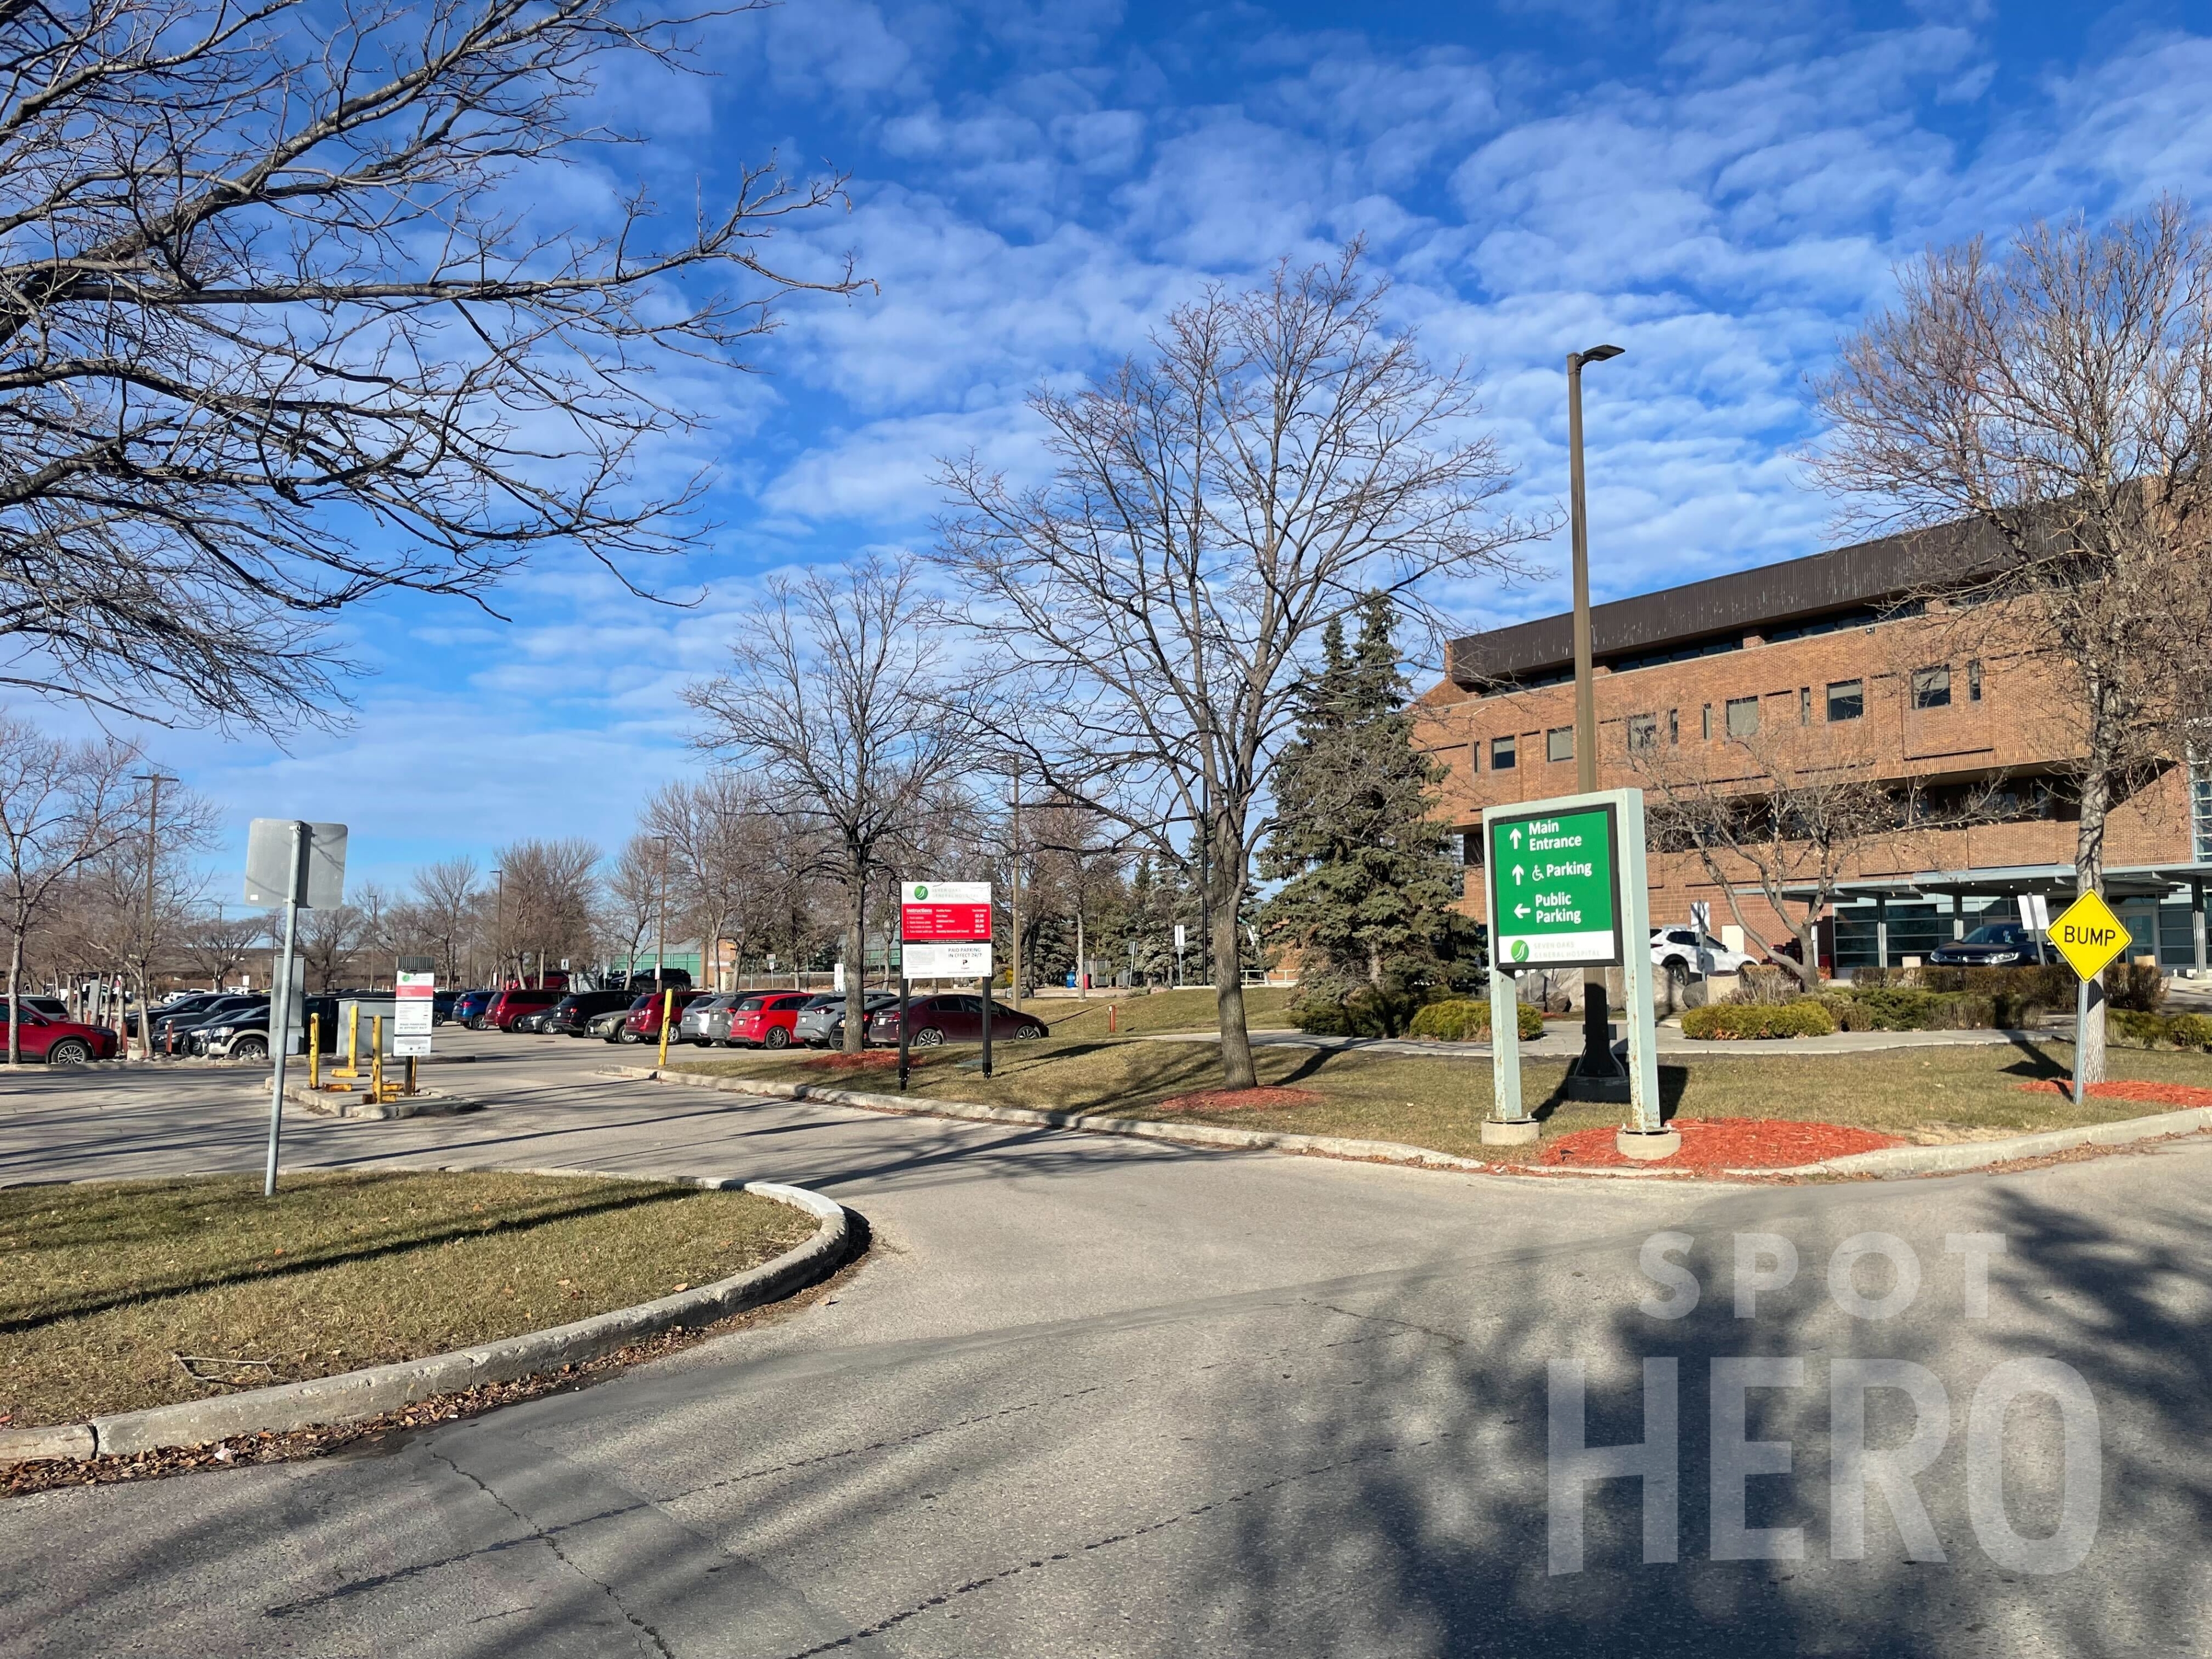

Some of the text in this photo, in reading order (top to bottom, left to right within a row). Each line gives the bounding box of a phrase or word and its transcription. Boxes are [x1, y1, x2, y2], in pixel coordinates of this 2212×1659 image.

[1529, 820, 1559, 835] Main
[1529, 835, 1582, 851] Entrance
[1546, 861, 1592, 877] Parking
[1535, 892, 1572, 907] Public
[1536, 908, 1581, 924] Parking
[2064, 925, 2116, 947] BUMP
